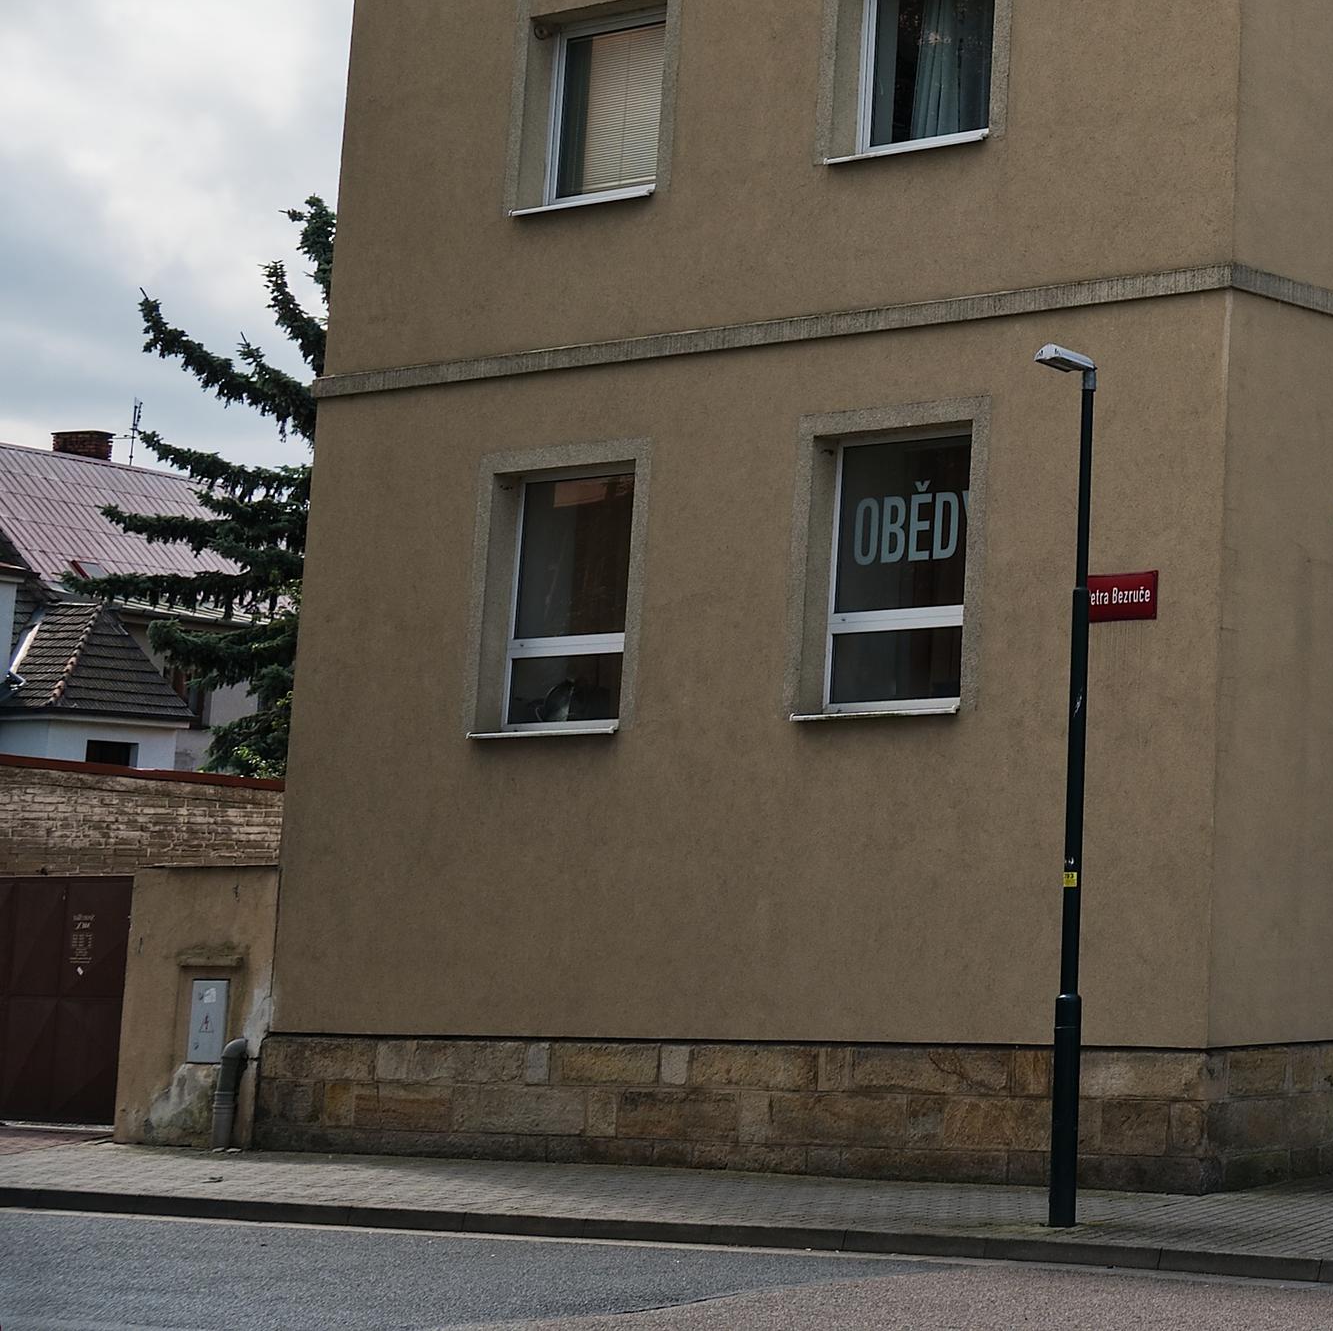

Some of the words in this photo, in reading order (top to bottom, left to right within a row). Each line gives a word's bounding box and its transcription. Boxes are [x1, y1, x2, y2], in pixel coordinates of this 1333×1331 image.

[854, 480, 969, 566] OBĚD
[1088, 589, 1109, 606] etra
[1112, 586, 1151, 604] Bezruče
